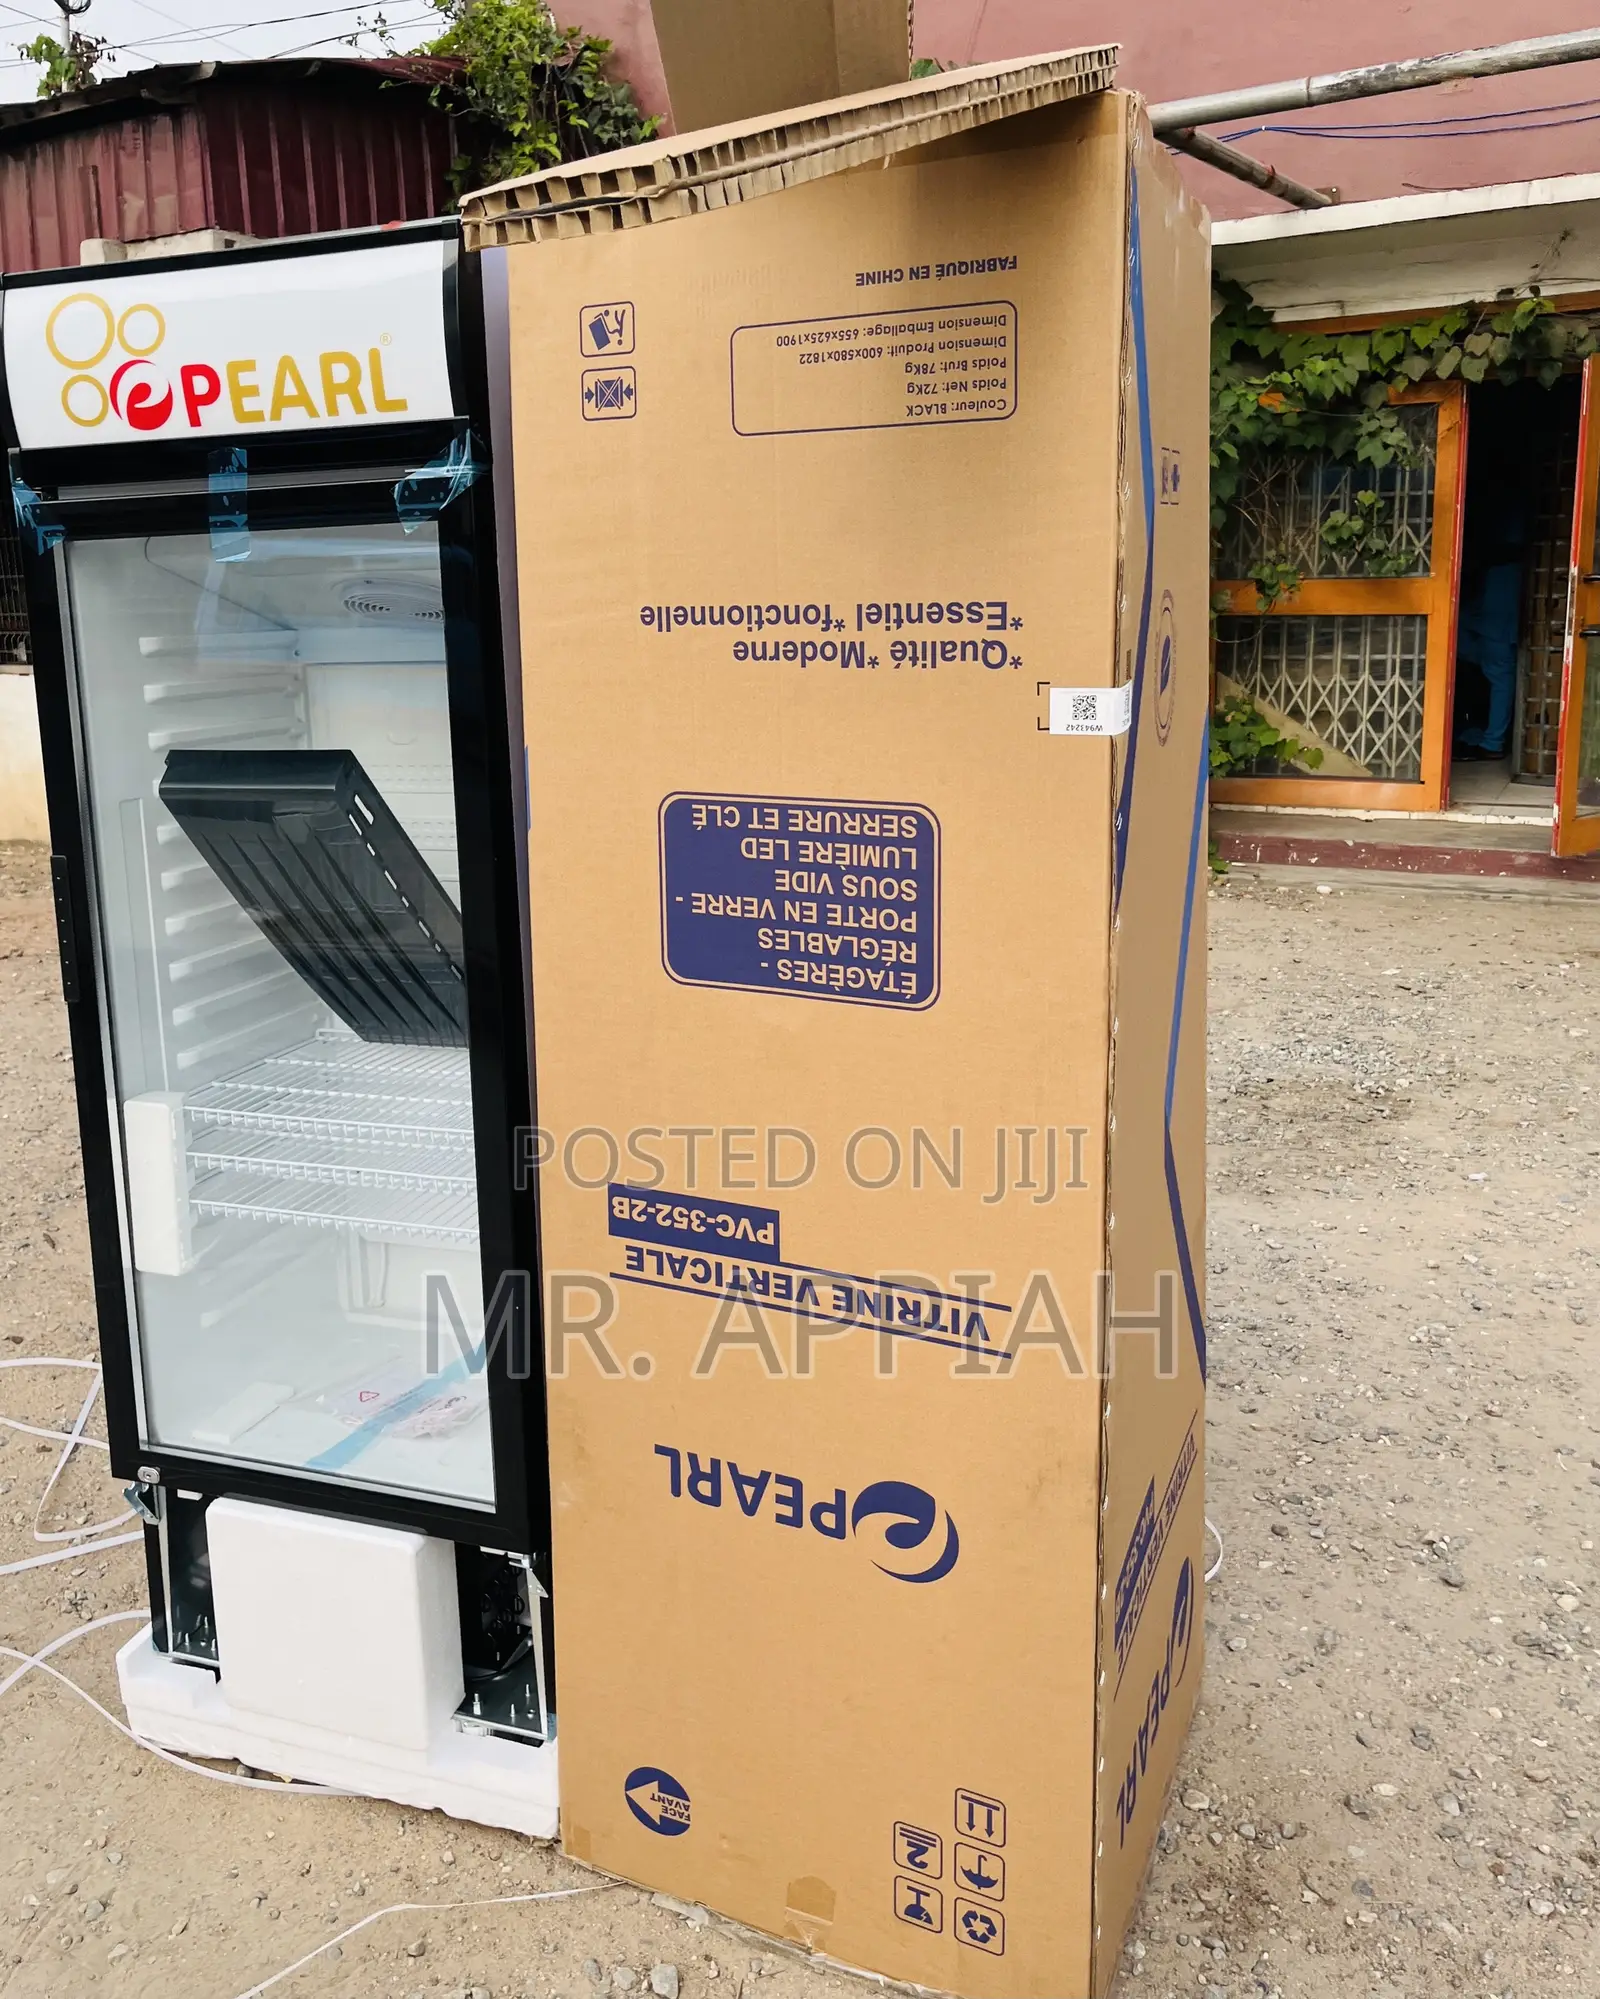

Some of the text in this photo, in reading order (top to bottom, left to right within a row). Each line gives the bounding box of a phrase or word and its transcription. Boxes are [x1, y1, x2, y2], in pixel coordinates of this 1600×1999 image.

[855, 255, 1018, 287] FABRIQUÉ EN CHINE
[776, 314, 1007, 347] Dimension Emballage: 655x625x1900
[799, 335, 1007, 365] Dimension Produit: 600x580x1822
[905, 357, 1007, 375] Poids Brut: 78Kg
[180, 347, 408, 427] PEARL
[906, 377, 1007, 395] Poids Net: 72Kg
[906, 398, 1007, 416] Couleur: BLACK
[691, 804, 918, 838] SERRURE ET CLÉ
[740, 837, 918, 870] LUMIÈRE LED
[774, 869, 918, 902] SOUS VIDE
[690, 892, 776, 920] VERRE
[784, 900, 817, 924] EN
[826, 903, 918, 933] PORTE
[757, 927, 918, 966] RÉGLABLES
[776, 959, 918, 999] ÉTAGÈRES
[611, 1195, 775, 1245] PVC-352-2B
[625, 1244, 991, 1342] VITRINE VERTICALE
[654, 1444, 846, 1540] PEARL
[1115, 1638, 1171, 1849] PEARL
[650, 1793, 692, 1812] AVANT
[661, 1805, 692, 1822] FACE
